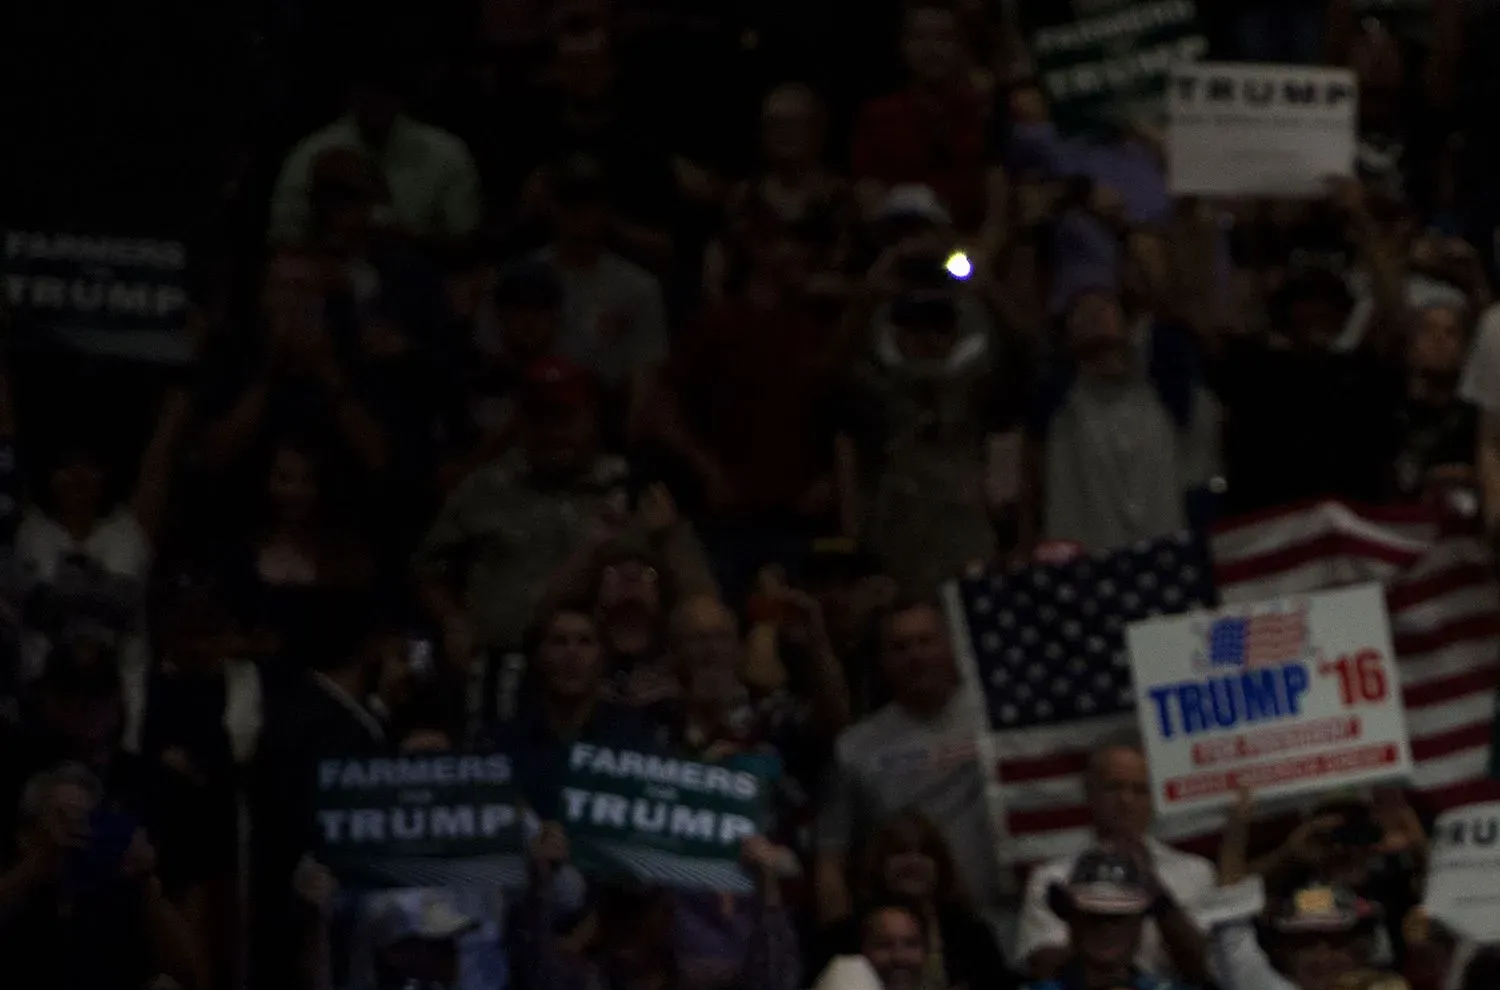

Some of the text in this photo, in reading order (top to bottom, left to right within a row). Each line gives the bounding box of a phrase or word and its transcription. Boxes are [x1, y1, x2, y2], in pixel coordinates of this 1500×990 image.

[1177, 76, 1349, 104] TRUMP
[1149, 664, 1308, 737] TRUMP
[317, 753, 513, 791] FARMERS
[568, 741, 758, 799] FARMERS
[315, 803, 516, 843] TRUMP
[562, 786, 755, 845] TRUMP
